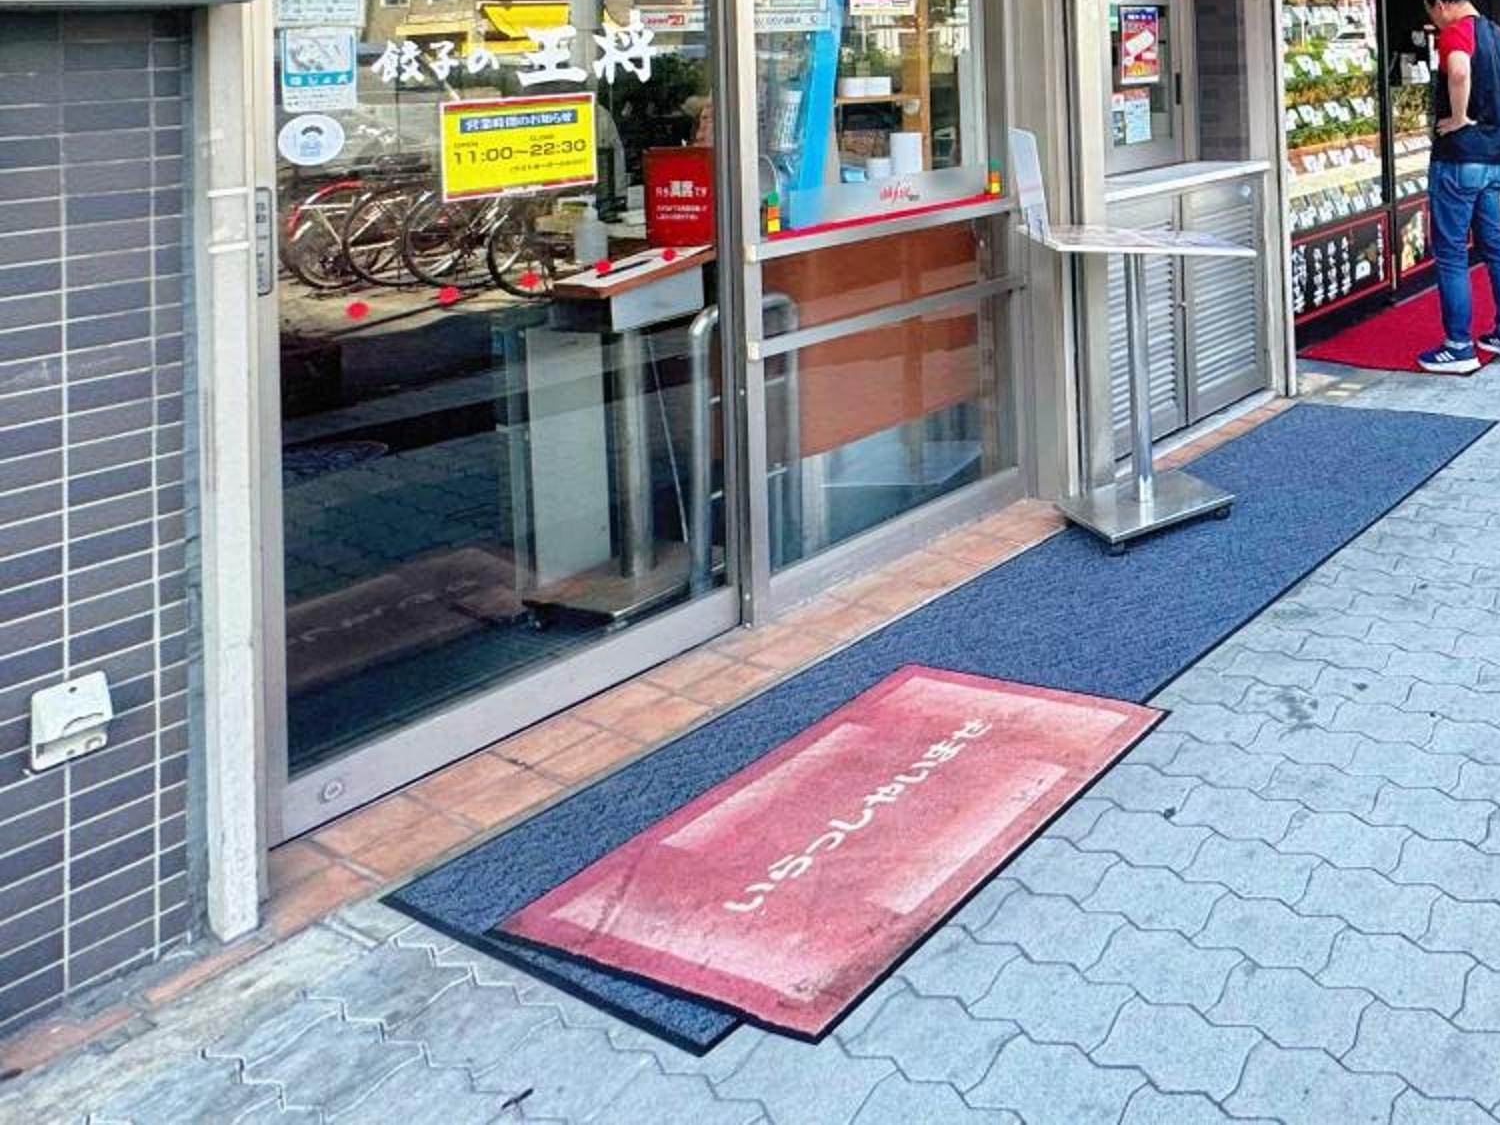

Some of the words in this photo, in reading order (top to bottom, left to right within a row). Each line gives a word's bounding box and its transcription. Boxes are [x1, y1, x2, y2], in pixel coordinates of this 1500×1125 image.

[370, 9, 659, 86] 餃子の王将
